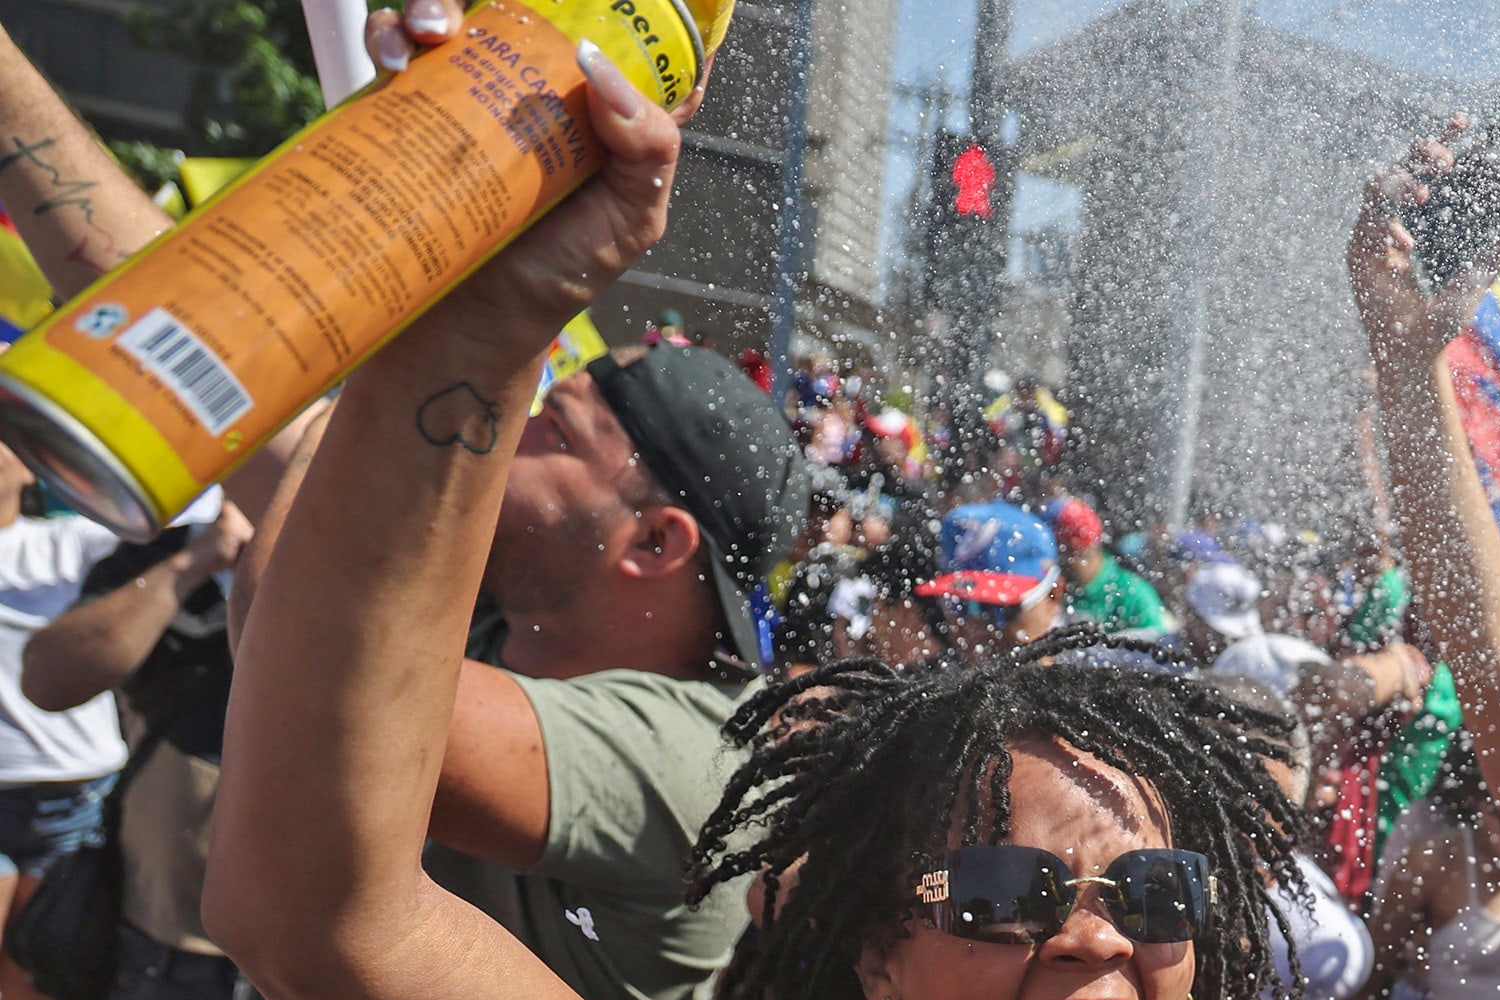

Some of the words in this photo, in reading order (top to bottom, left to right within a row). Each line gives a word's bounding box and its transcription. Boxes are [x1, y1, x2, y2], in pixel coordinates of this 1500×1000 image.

[610, 0, 659, 46] per
[466, 27, 521, 68] PARA
[519, 65, 586, 167] CARNAVAL
